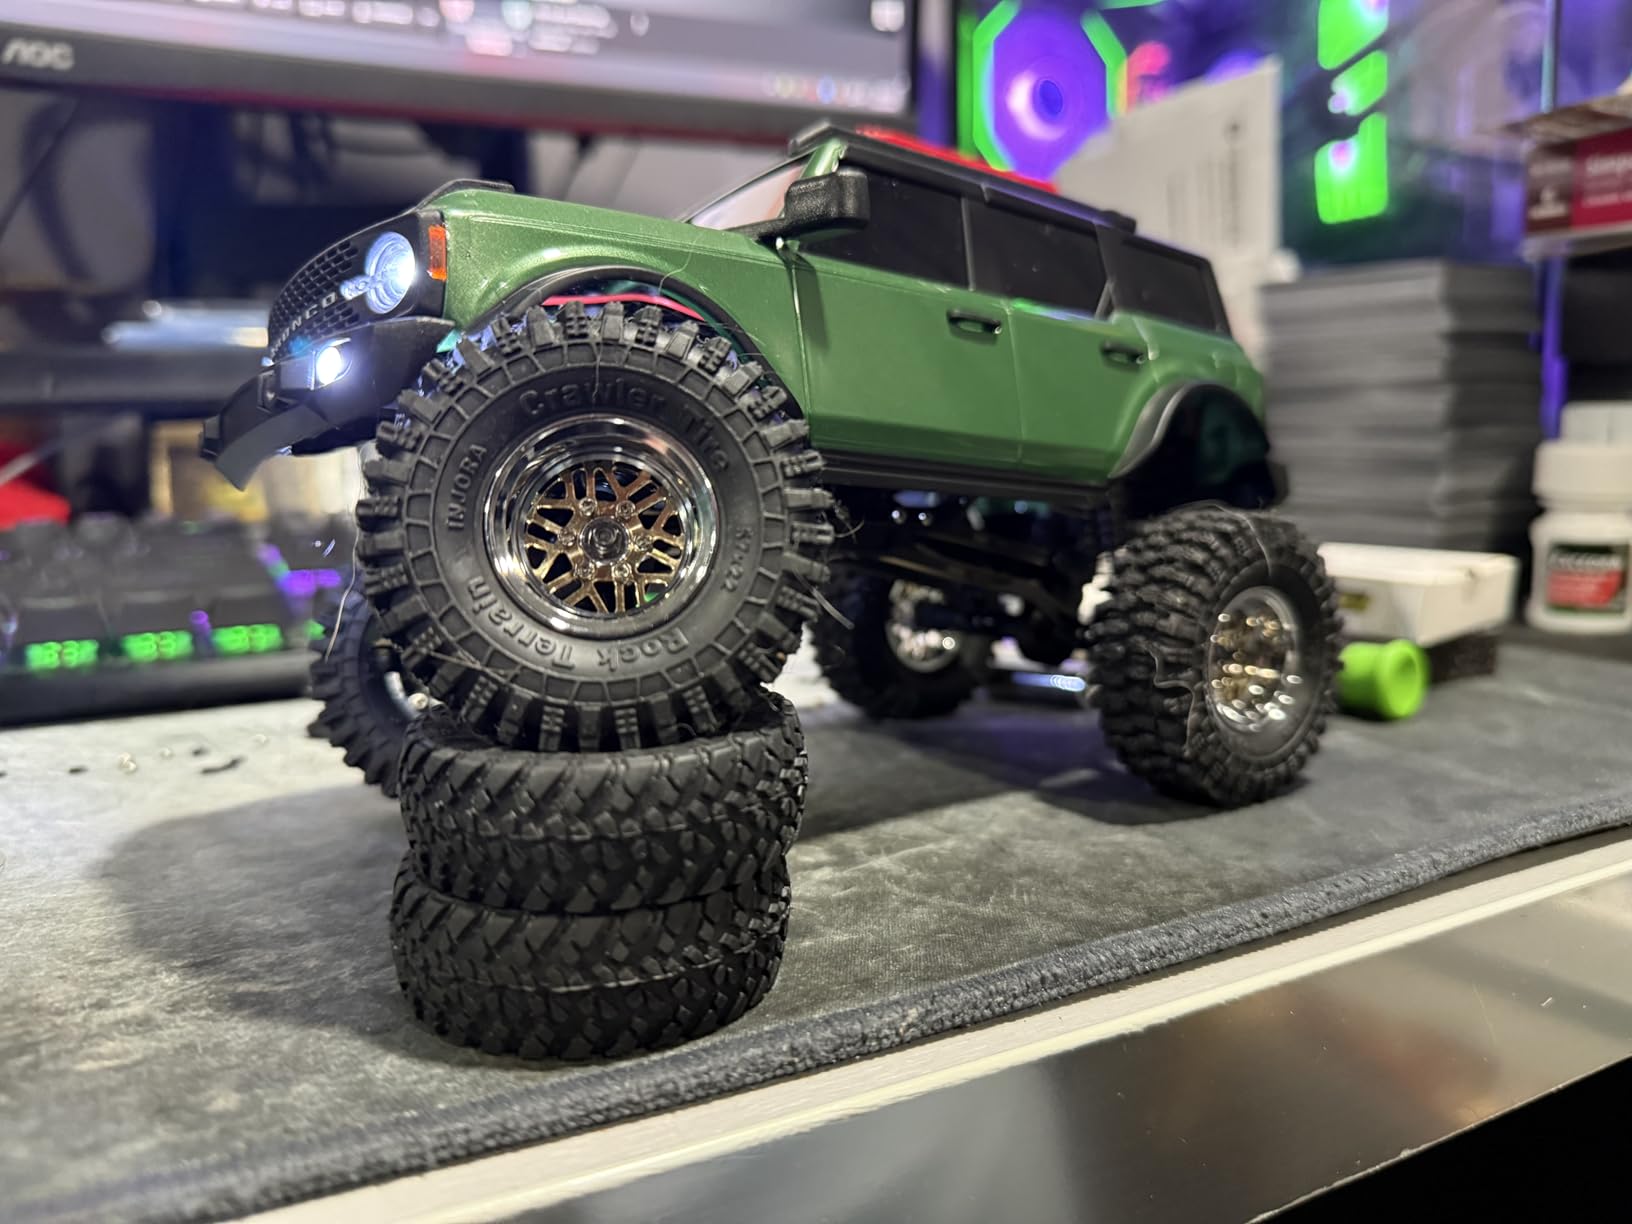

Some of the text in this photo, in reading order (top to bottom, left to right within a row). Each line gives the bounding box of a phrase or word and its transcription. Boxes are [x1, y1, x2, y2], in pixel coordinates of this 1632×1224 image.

[1, 37, 75, 71] AOC
[519, 376, 730, 473] Crawler Tire
[447, 443, 488, 529] INJORA
[466, 575, 690, 672] Rock Terrain
